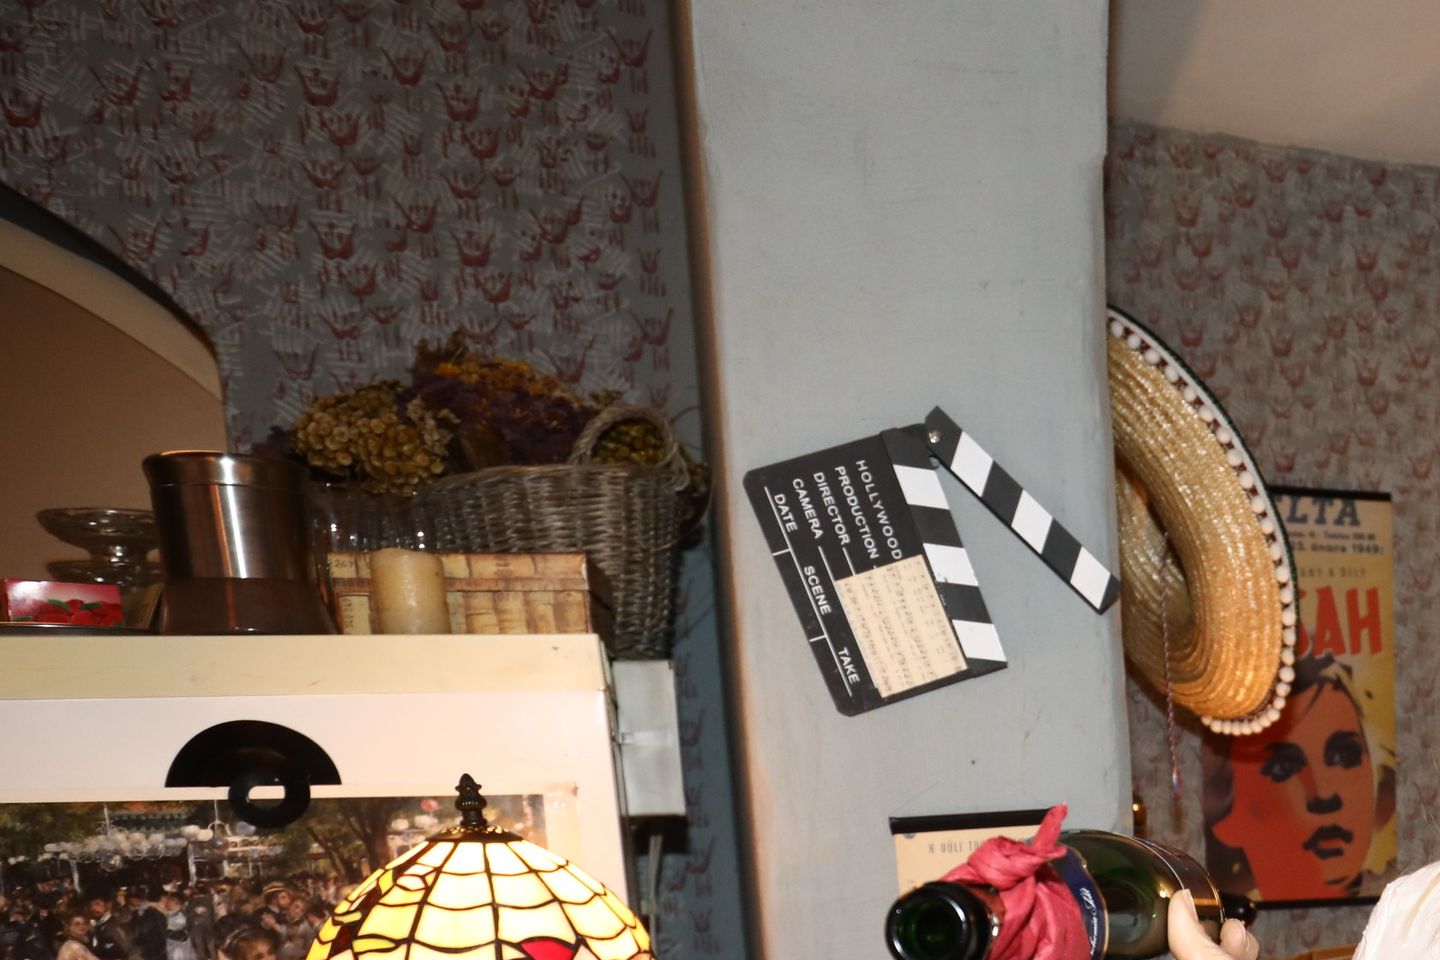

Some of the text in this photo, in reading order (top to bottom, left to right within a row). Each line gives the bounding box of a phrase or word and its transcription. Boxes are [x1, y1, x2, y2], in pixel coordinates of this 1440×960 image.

[774, 493, 798, 533] DATE
[792, 478, 824, 540] CAMERA
[813, 471, 851, 545] DIRECTOR
[834, 465, 880, 559] PRODUCTION
[856, 459, 903, 560] HOLLYWOOD
[803, 565, 832, 616] SCENE
[838, 646, 861, 684] TAKE
